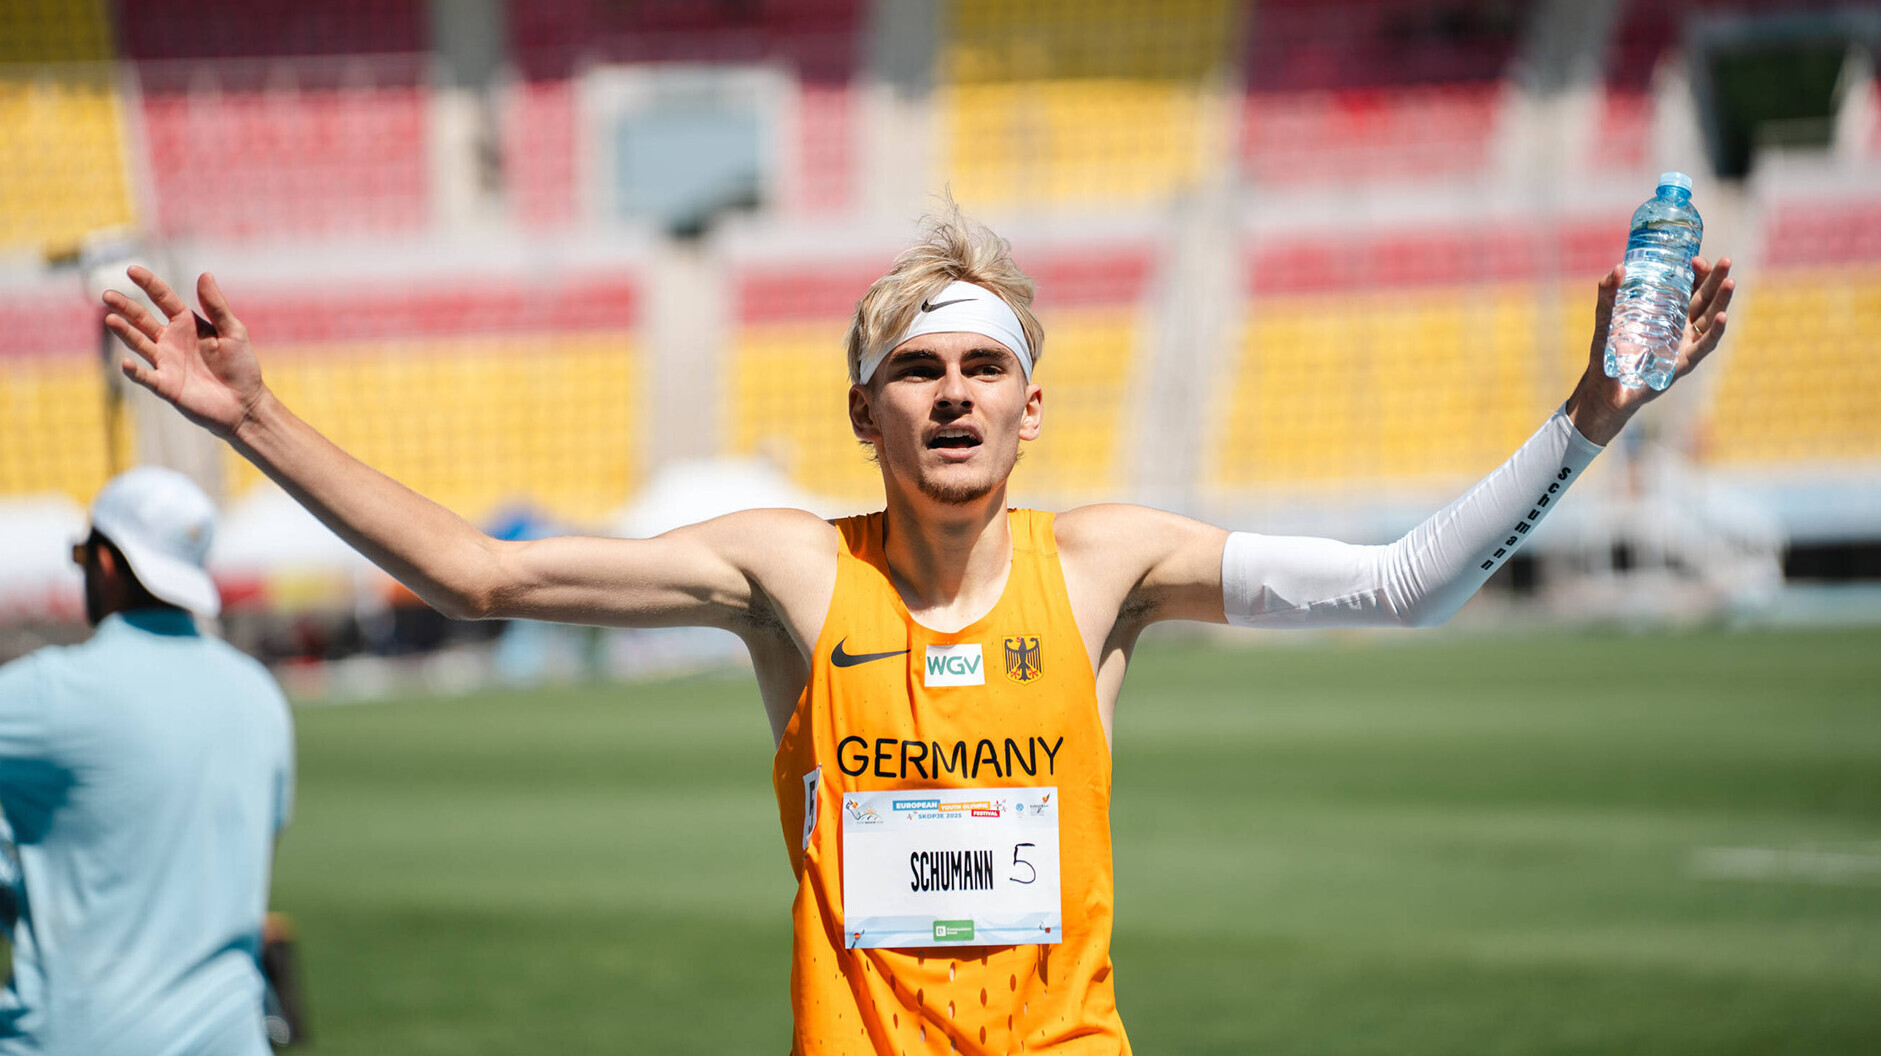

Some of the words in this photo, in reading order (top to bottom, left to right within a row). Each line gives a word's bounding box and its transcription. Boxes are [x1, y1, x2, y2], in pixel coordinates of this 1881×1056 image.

[1480, 467, 1571, 570] Schumann
[926, 654, 981, 675] WGV
[837, 735, 1064, 779] GERMANY
[910, 850, 994, 892] SCHUMANN
[1009, 843, 1036, 884] 5
